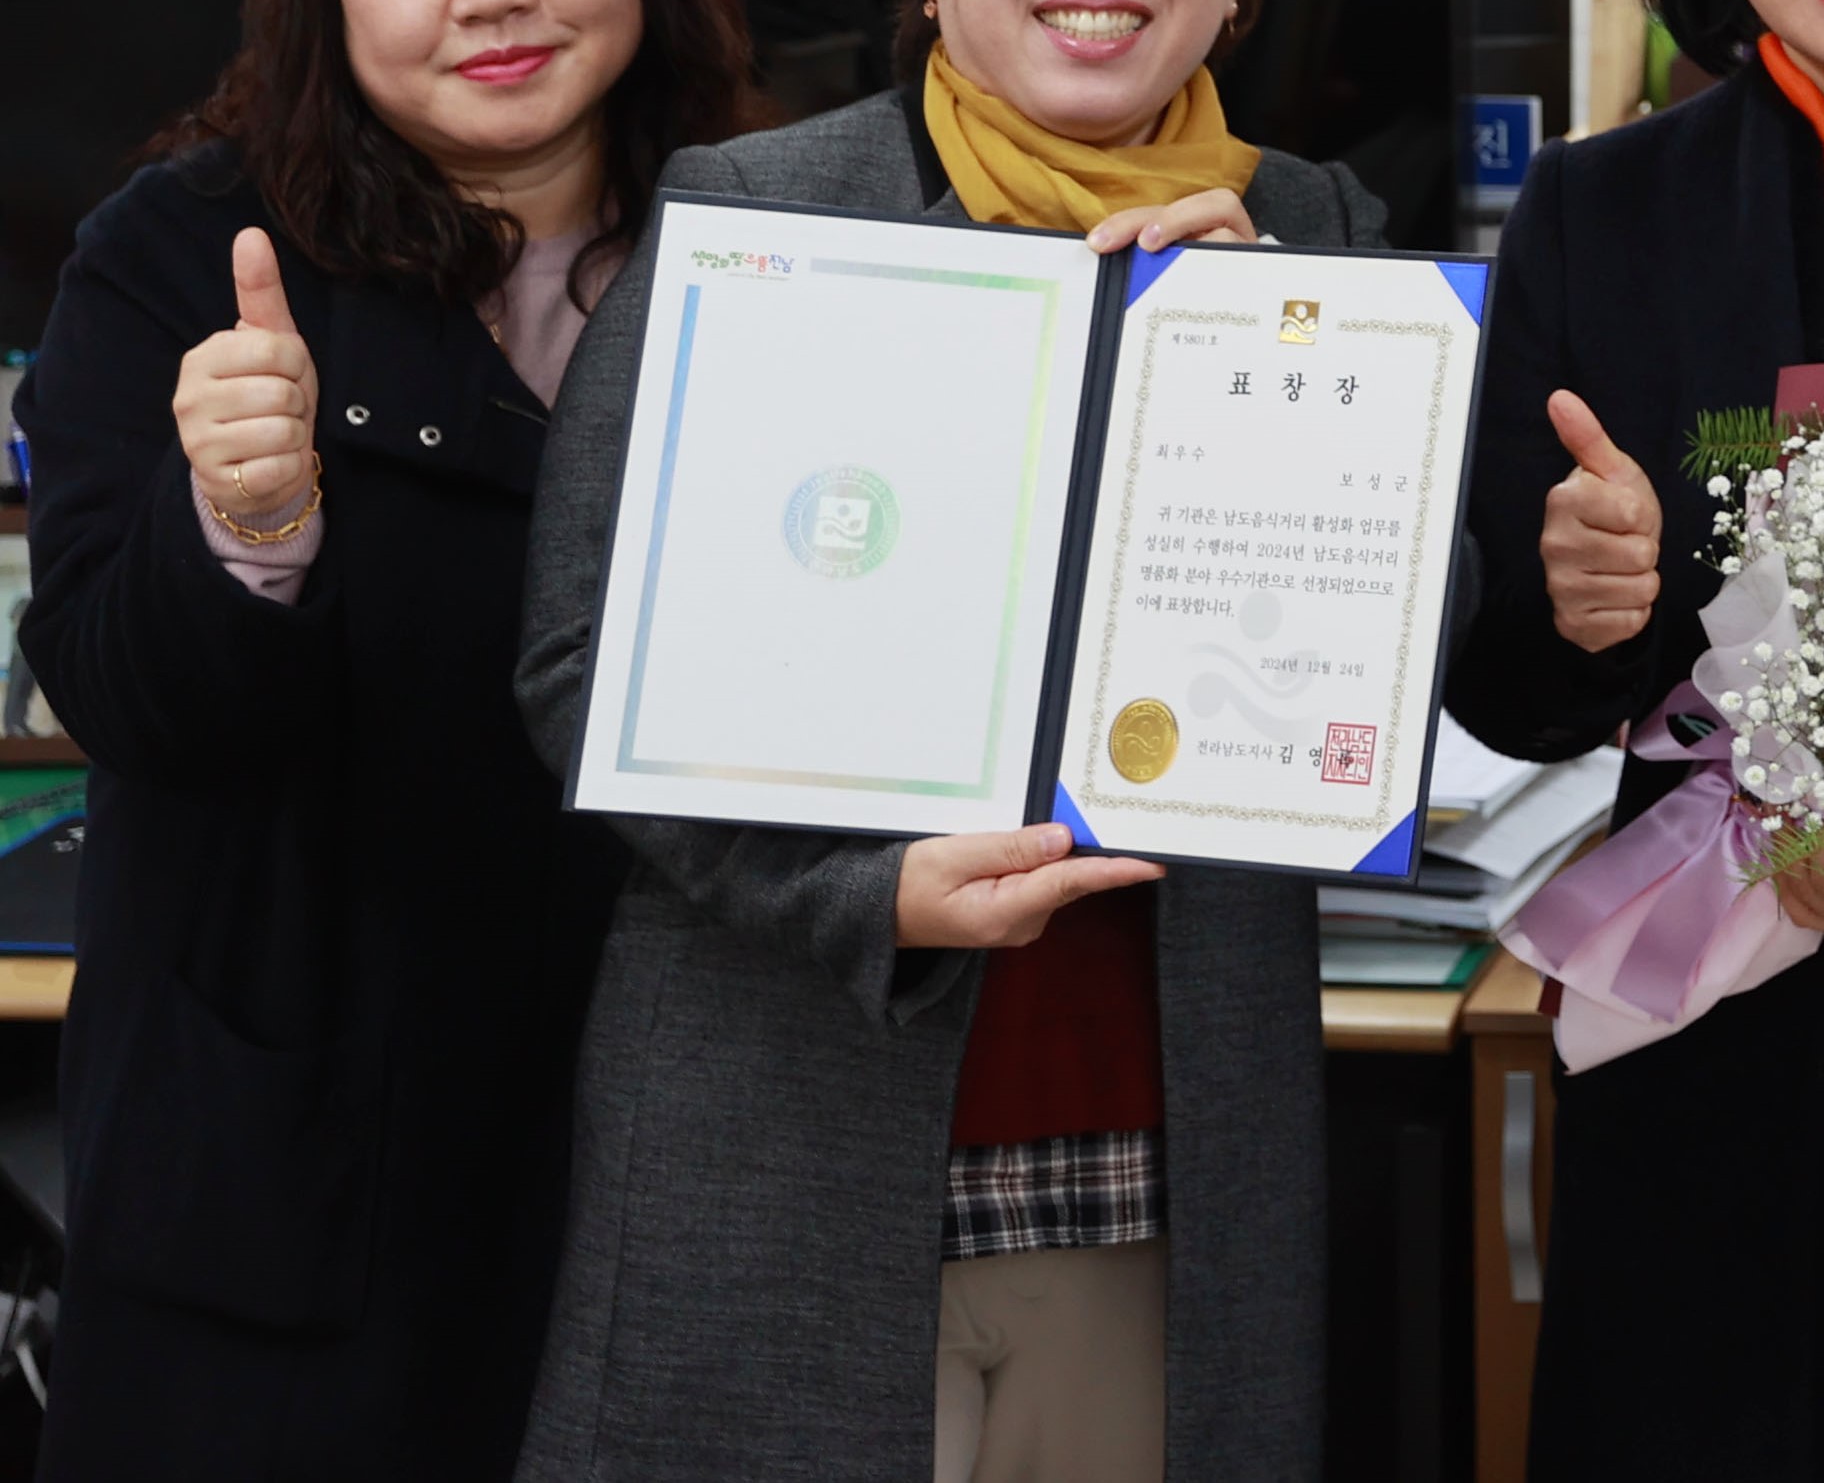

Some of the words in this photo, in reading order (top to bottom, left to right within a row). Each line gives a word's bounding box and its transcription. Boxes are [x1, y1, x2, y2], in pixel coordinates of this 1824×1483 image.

[1228, 371, 1360, 405] 표창장
[1178, 506, 1218, 526] 기관은
[1224, 509, 1306, 532] 남도음식거리
[1312, 515, 1355, 534] 활성화
[1360, 518, 1401, 538] 업무를
[1144, 534, 1185, 554] 성실히
[1193, 537, 1249, 557] 수행하여
[1256, 542, 1305, 562] 2024년
[1313, 545, 1399, 568] 남도음식거리
[1140, 564, 1179, 583] 명품화
[1185, 566, 1212, 585] 분야
[1217, 568, 1296, 590] 우수기관으로
[1302, 575, 1395, 596] 선정되었으므로
[1197, 741, 1273, 761] 전라남도지사
